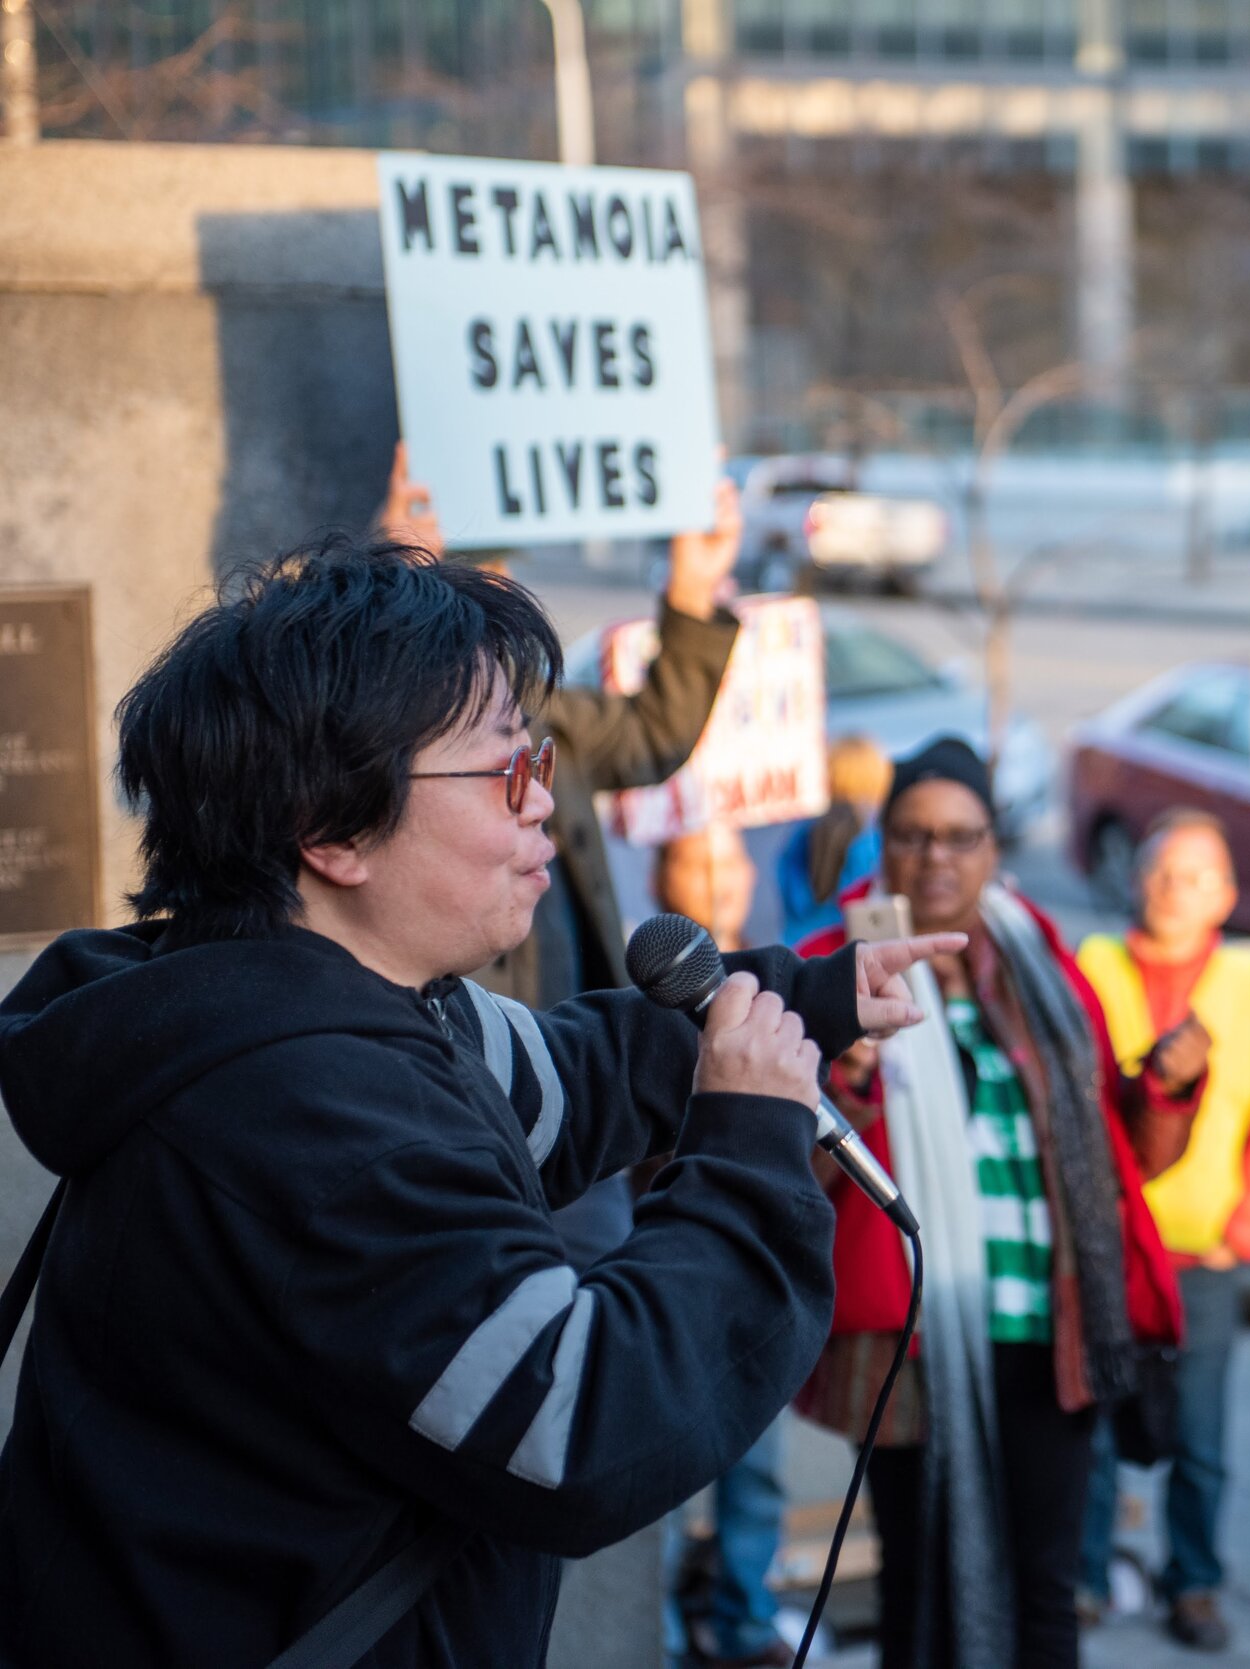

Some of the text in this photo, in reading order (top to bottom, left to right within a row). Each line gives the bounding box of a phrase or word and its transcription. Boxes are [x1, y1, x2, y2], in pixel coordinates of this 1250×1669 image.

[396, 176, 690, 262] METANOIA
[469, 315, 655, 390] SAVES
[495, 439, 659, 517] LIVES
